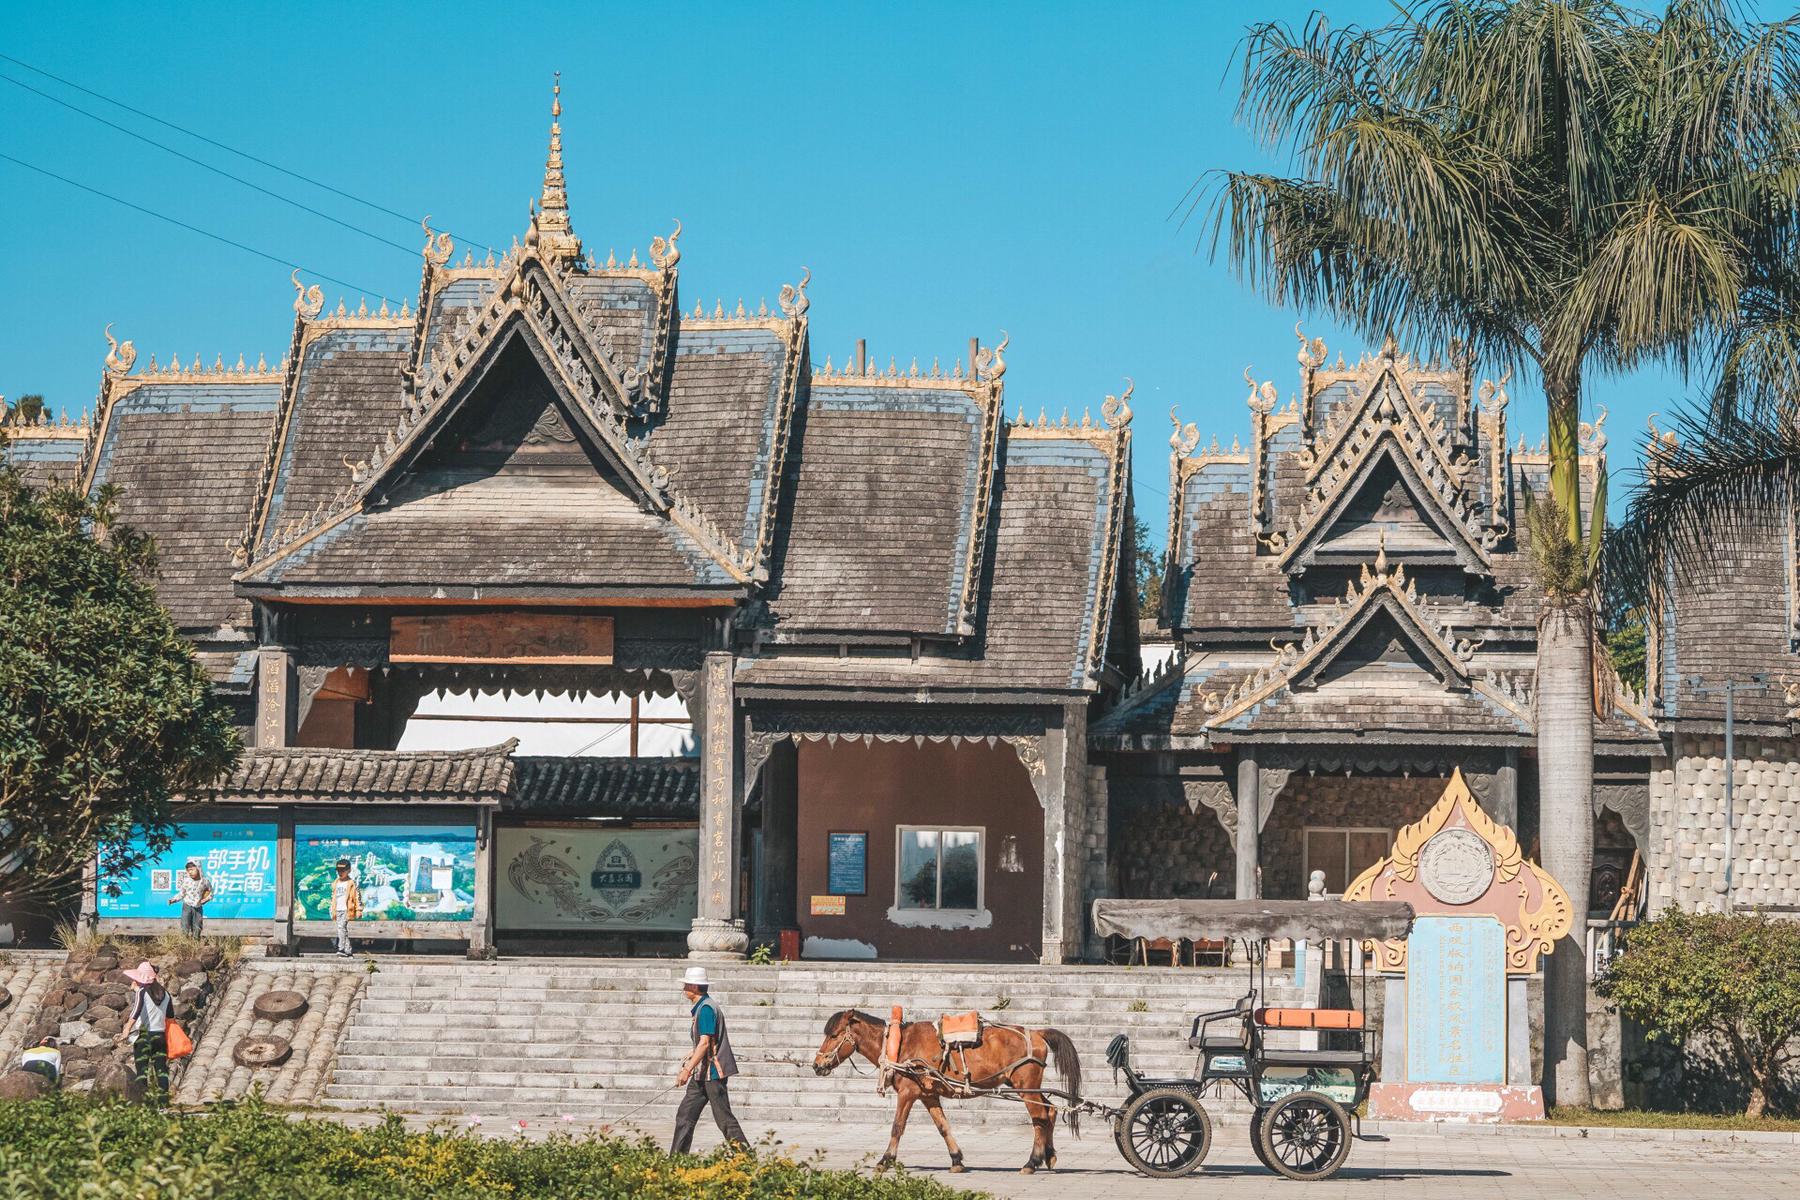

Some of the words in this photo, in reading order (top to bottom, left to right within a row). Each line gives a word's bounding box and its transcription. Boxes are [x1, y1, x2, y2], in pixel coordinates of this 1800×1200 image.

[187, 846, 270, 870] 一部手机
[207, 871, 265, 896] 游云南
